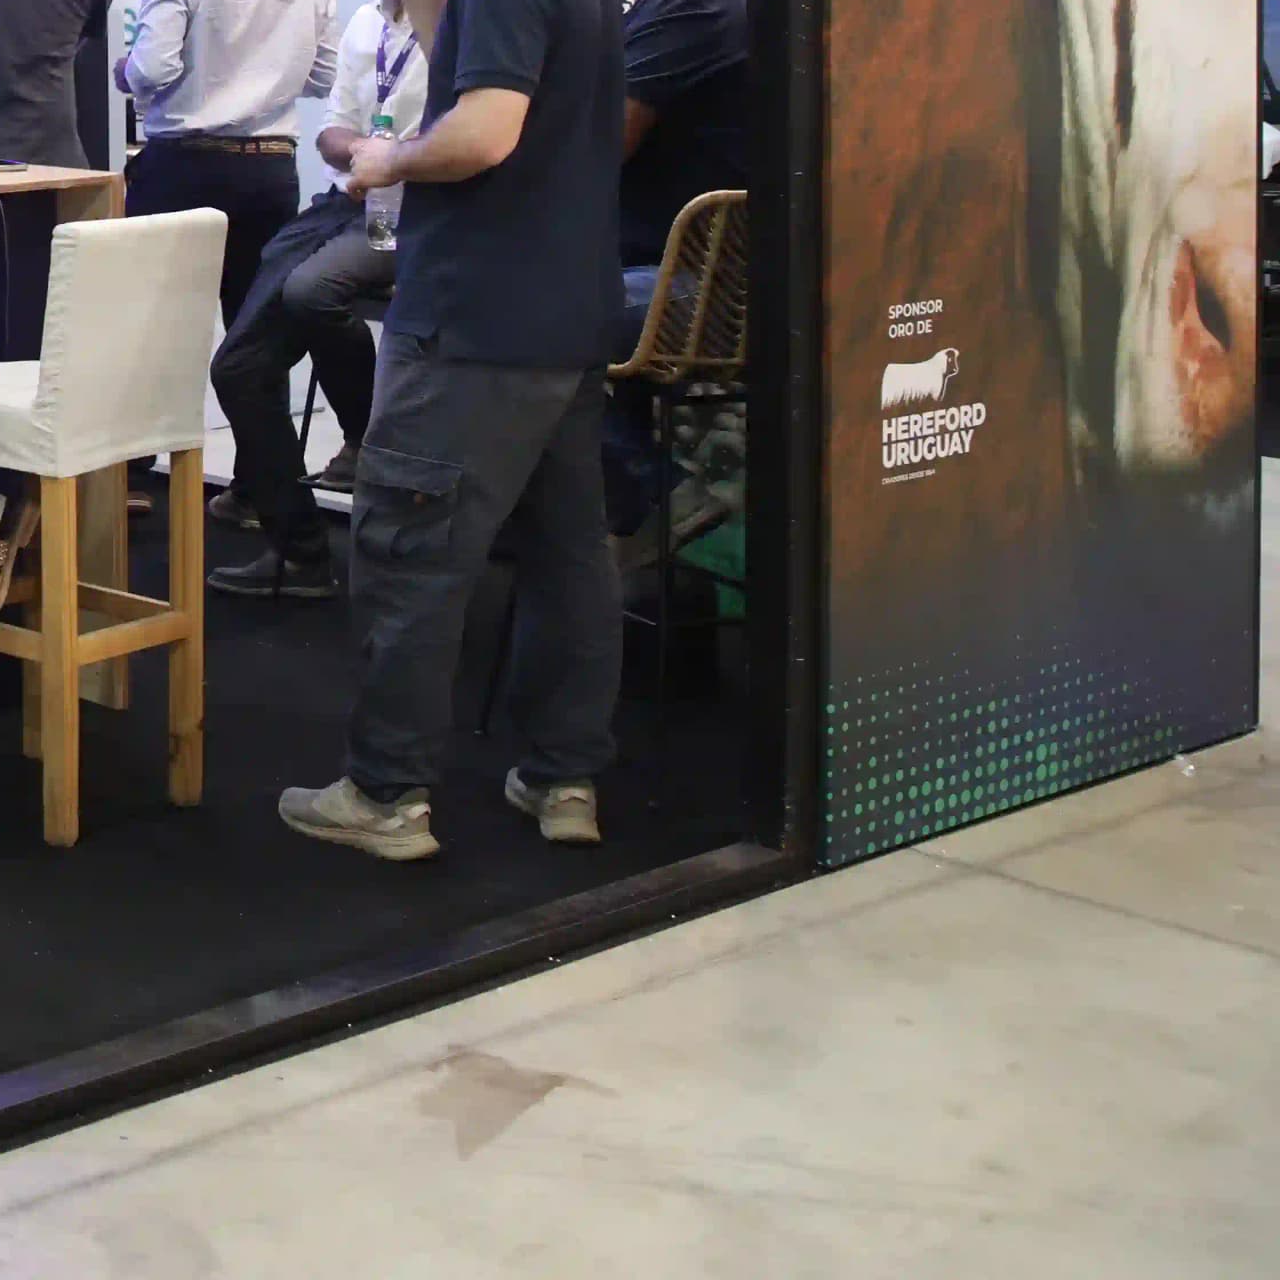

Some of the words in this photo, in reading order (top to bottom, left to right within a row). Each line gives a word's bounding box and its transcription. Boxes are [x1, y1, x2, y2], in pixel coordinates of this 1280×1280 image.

[888, 298, 943, 319] SPONSOR
[889, 322, 914, 338] ORO
[916, 319, 933, 334] DE
[882, 402, 986, 443] HEREFORD
[883, 429, 975, 468] URUGUAY
